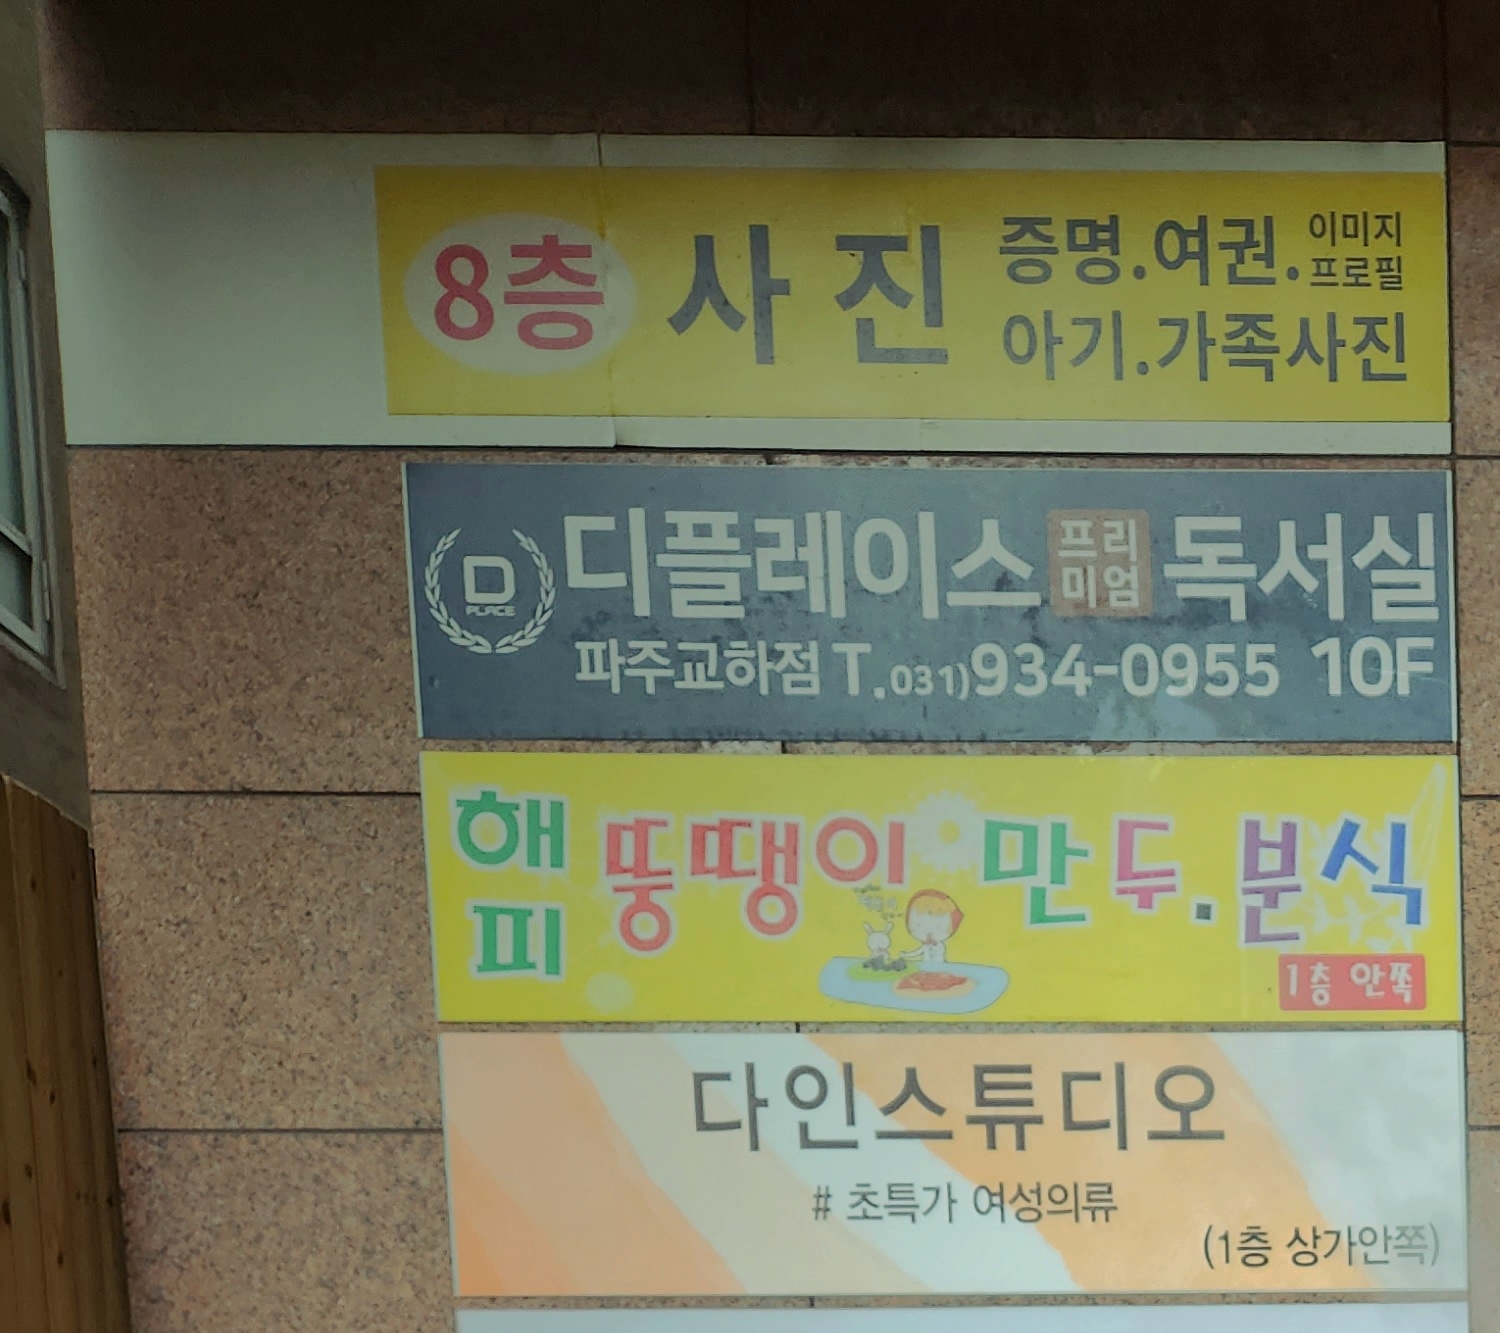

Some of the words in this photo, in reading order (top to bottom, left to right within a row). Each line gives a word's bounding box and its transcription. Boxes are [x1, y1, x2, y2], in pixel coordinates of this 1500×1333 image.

[1309, 211, 1402, 248] 이미지
[434, 233, 605, 351] 8층
[667, 223, 950, 366] 사진
[1309, 256, 1404, 291] 프로필
[1003, 309, 1408, 383] 아기.가족사진
[562, 506, 1042, 621] 디플레이스
[1162, 510, 1440, 622] 독서실
[575, 637, 821, 697] 파주교하점
[1310, 636, 1434, 698] 10F
[1287, 961, 1332, 1006] 1층
[1350, 961, 1413, 1005] 안쪽
[692, 1061, 1226, 1153] 다인스튜디오
[845, 1181, 957, 1225] 초특가
[972, 1181, 1119, 1224] 여성의류
[1203, 1223, 1272, 1270] (1층
[1285, 1222, 1441, 1268] 상가안쪽)
